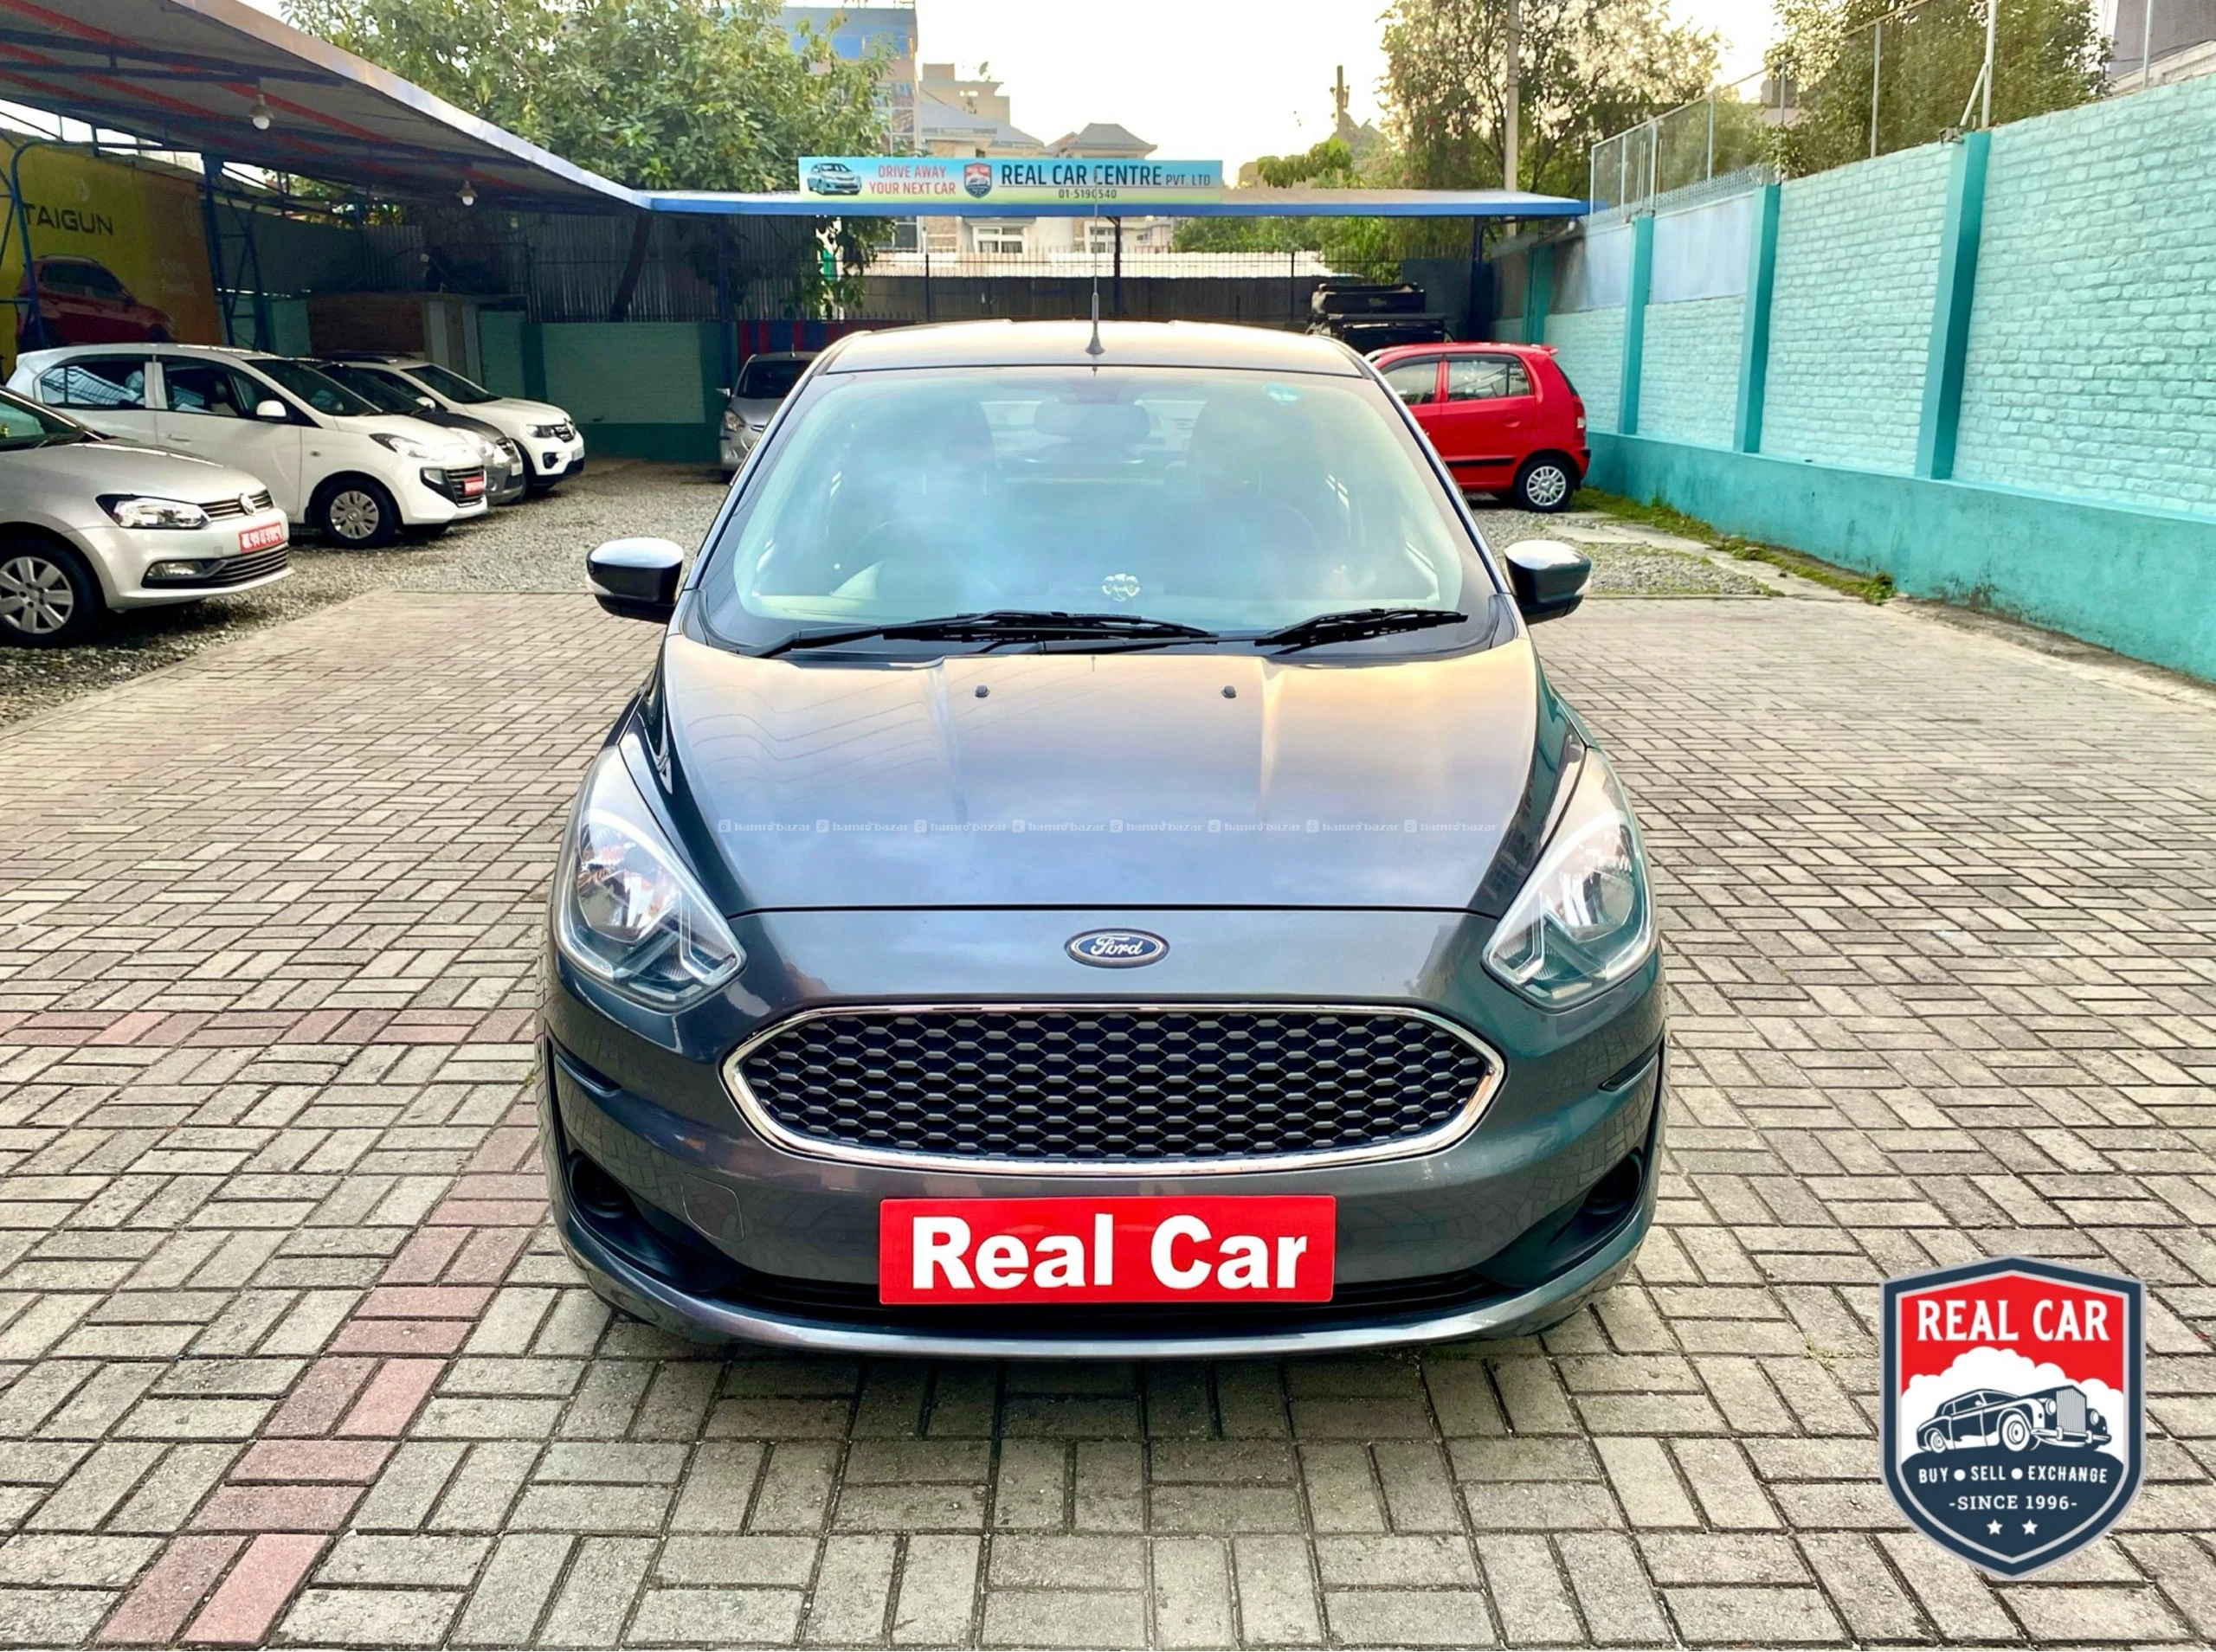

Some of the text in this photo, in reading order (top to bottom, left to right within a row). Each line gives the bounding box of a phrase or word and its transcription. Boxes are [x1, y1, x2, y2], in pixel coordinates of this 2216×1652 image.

[878, 165, 946, 178] DRIVE AWAY
[1001, 164, 1047, 185] REAL
[1053, 164, 1087, 185] CAR
[1093, 165, 1163, 185] CENTRE
[869, 182, 956, 195] YOUR NEXT CAR
[23, 202, 114, 236] TAIGUN
[1091, 935, 1143, 955] Ford
[912, 1212, 1308, 1289] Real Car
